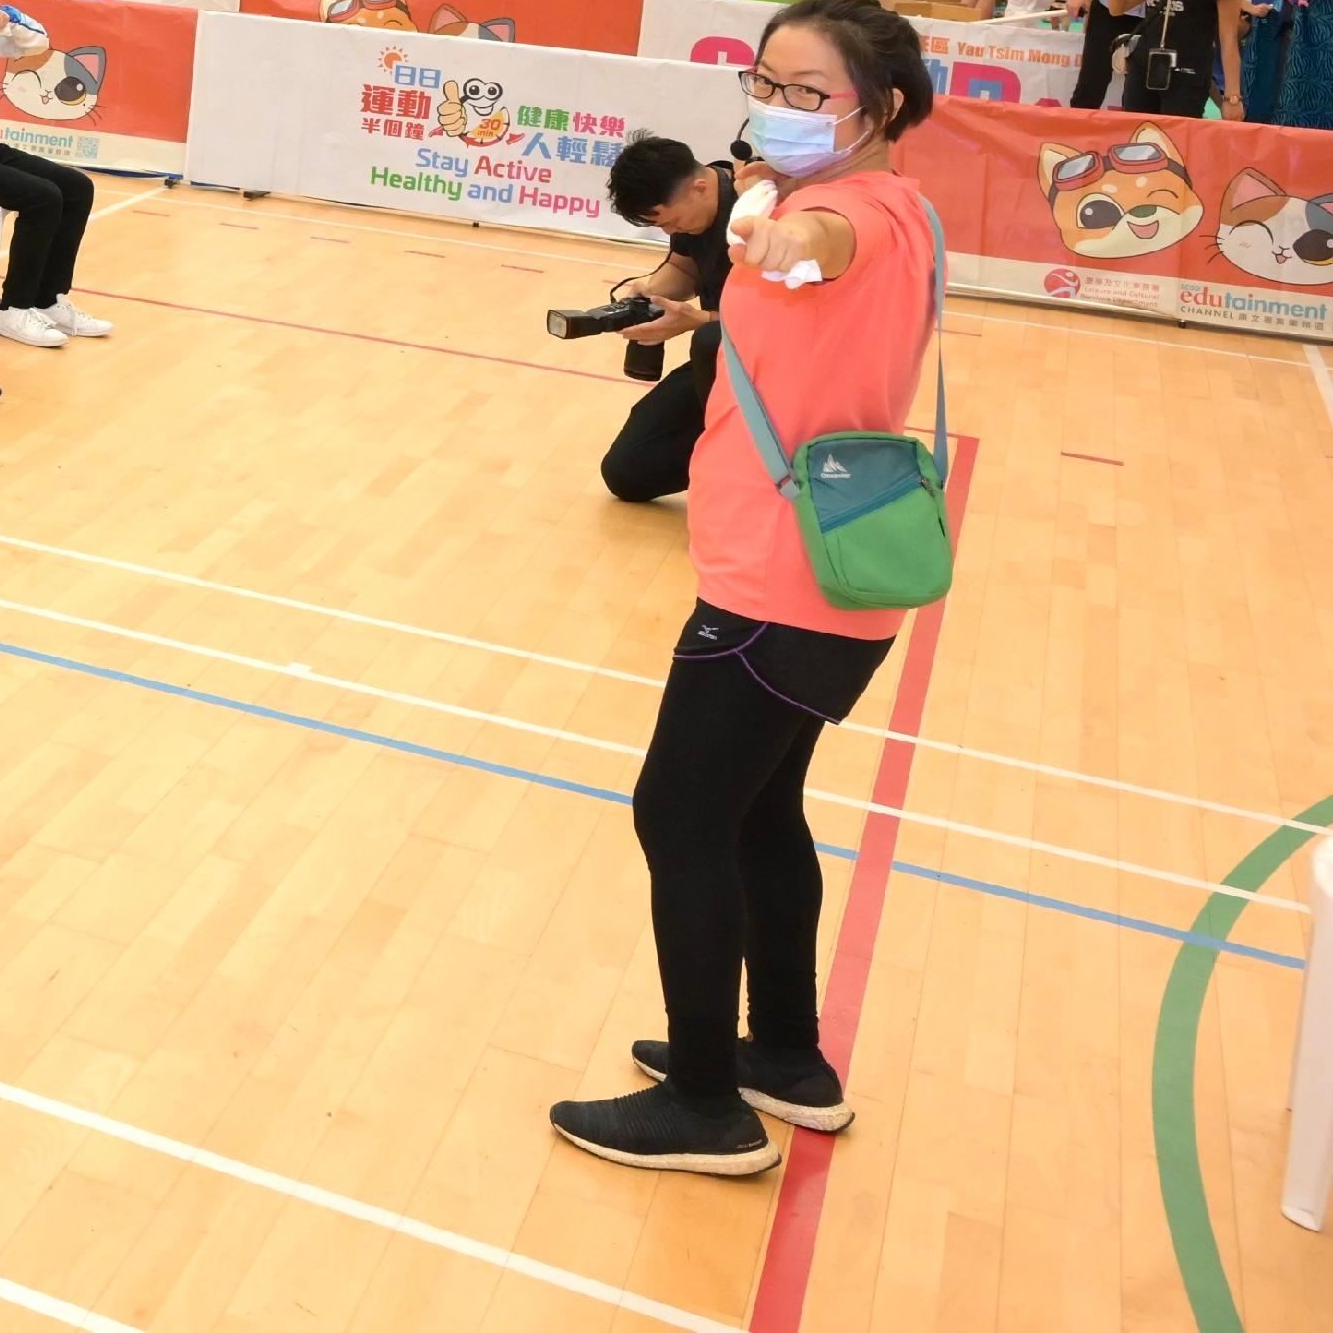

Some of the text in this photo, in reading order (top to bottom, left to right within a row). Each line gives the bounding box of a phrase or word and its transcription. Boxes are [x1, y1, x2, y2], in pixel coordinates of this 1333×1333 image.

[957, 41, 984, 57] Yau
[988, 45, 1025, 63] Tsim
[1028, 49, 1071, 68] Mong
[394, 64, 442, 89] 日日
[360, 83, 432, 120] 運動
[361, 117, 426, 142] 半個鐘
[476, 130, 494, 138] min
[479, 118, 501, 132] 30
[517, 105, 626, 138] 健康快樂
[522, 132, 623, 168] 人輕鬆
[415, 147, 552, 184] Stay Active
[370, 165, 600, 219] Healthy and Happy
[1180, 286, 1327, 321] edutainment
[1180, 306, 1234, 320] CHANNEL
